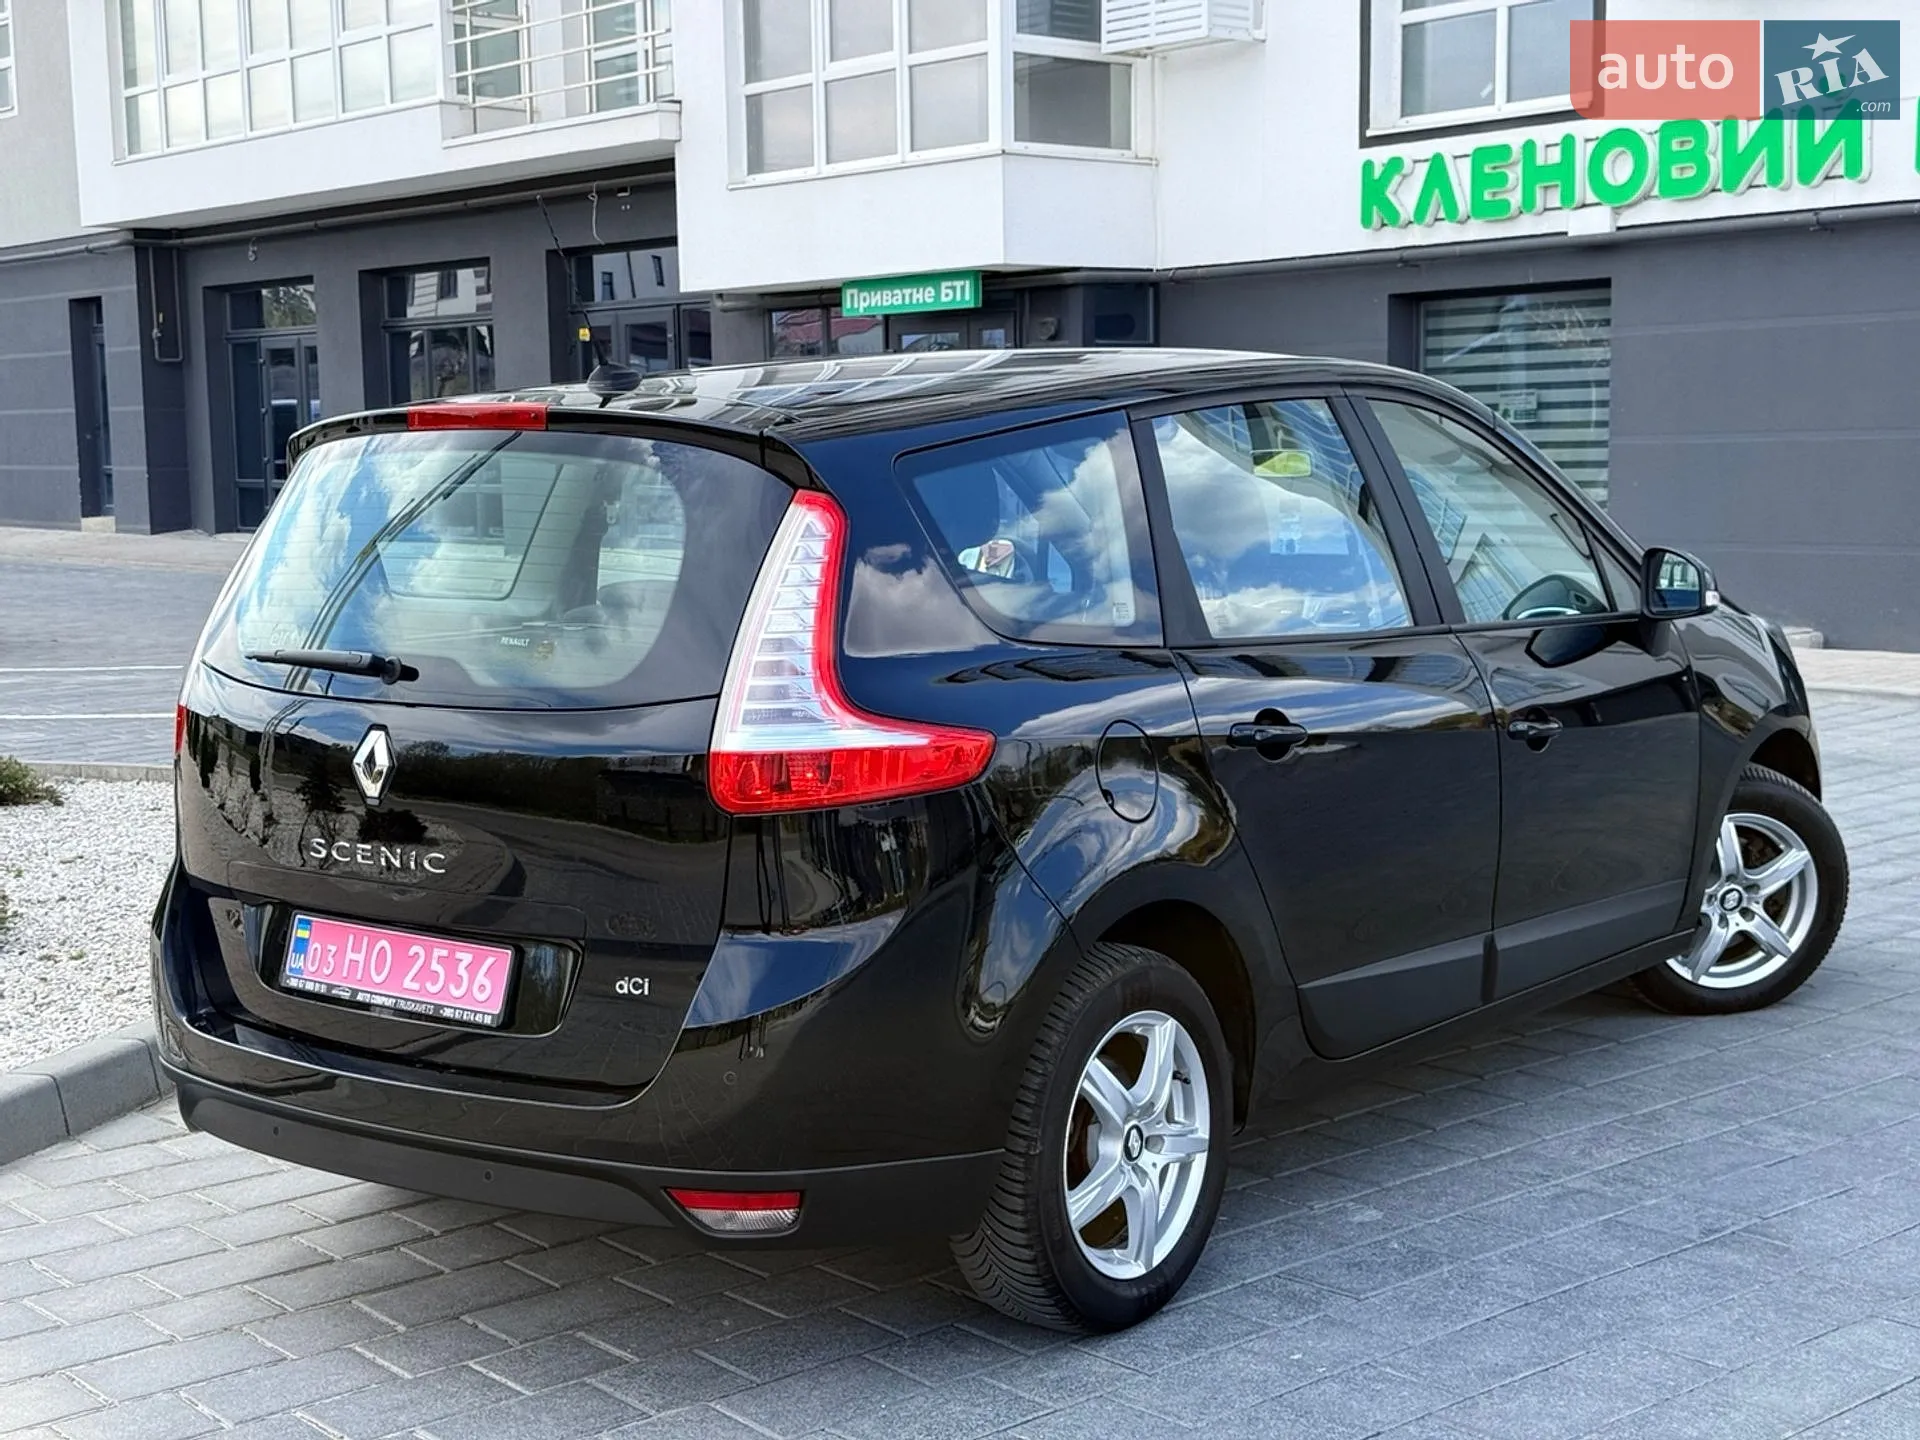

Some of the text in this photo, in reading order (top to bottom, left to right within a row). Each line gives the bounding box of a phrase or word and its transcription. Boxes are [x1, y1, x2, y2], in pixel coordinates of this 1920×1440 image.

[1360, 74, 1868, 230] КЛЕНОВИЙ
[845, 279, 970, 312] Приватне БТІ
[309, 838, 446, 873] SCENIC
[290, 952, 304, 969] UA
[307, 942, 336, 976] 03
[402, 944, 497, 1003] 2536
[615, 976, 650, 996] dCi
